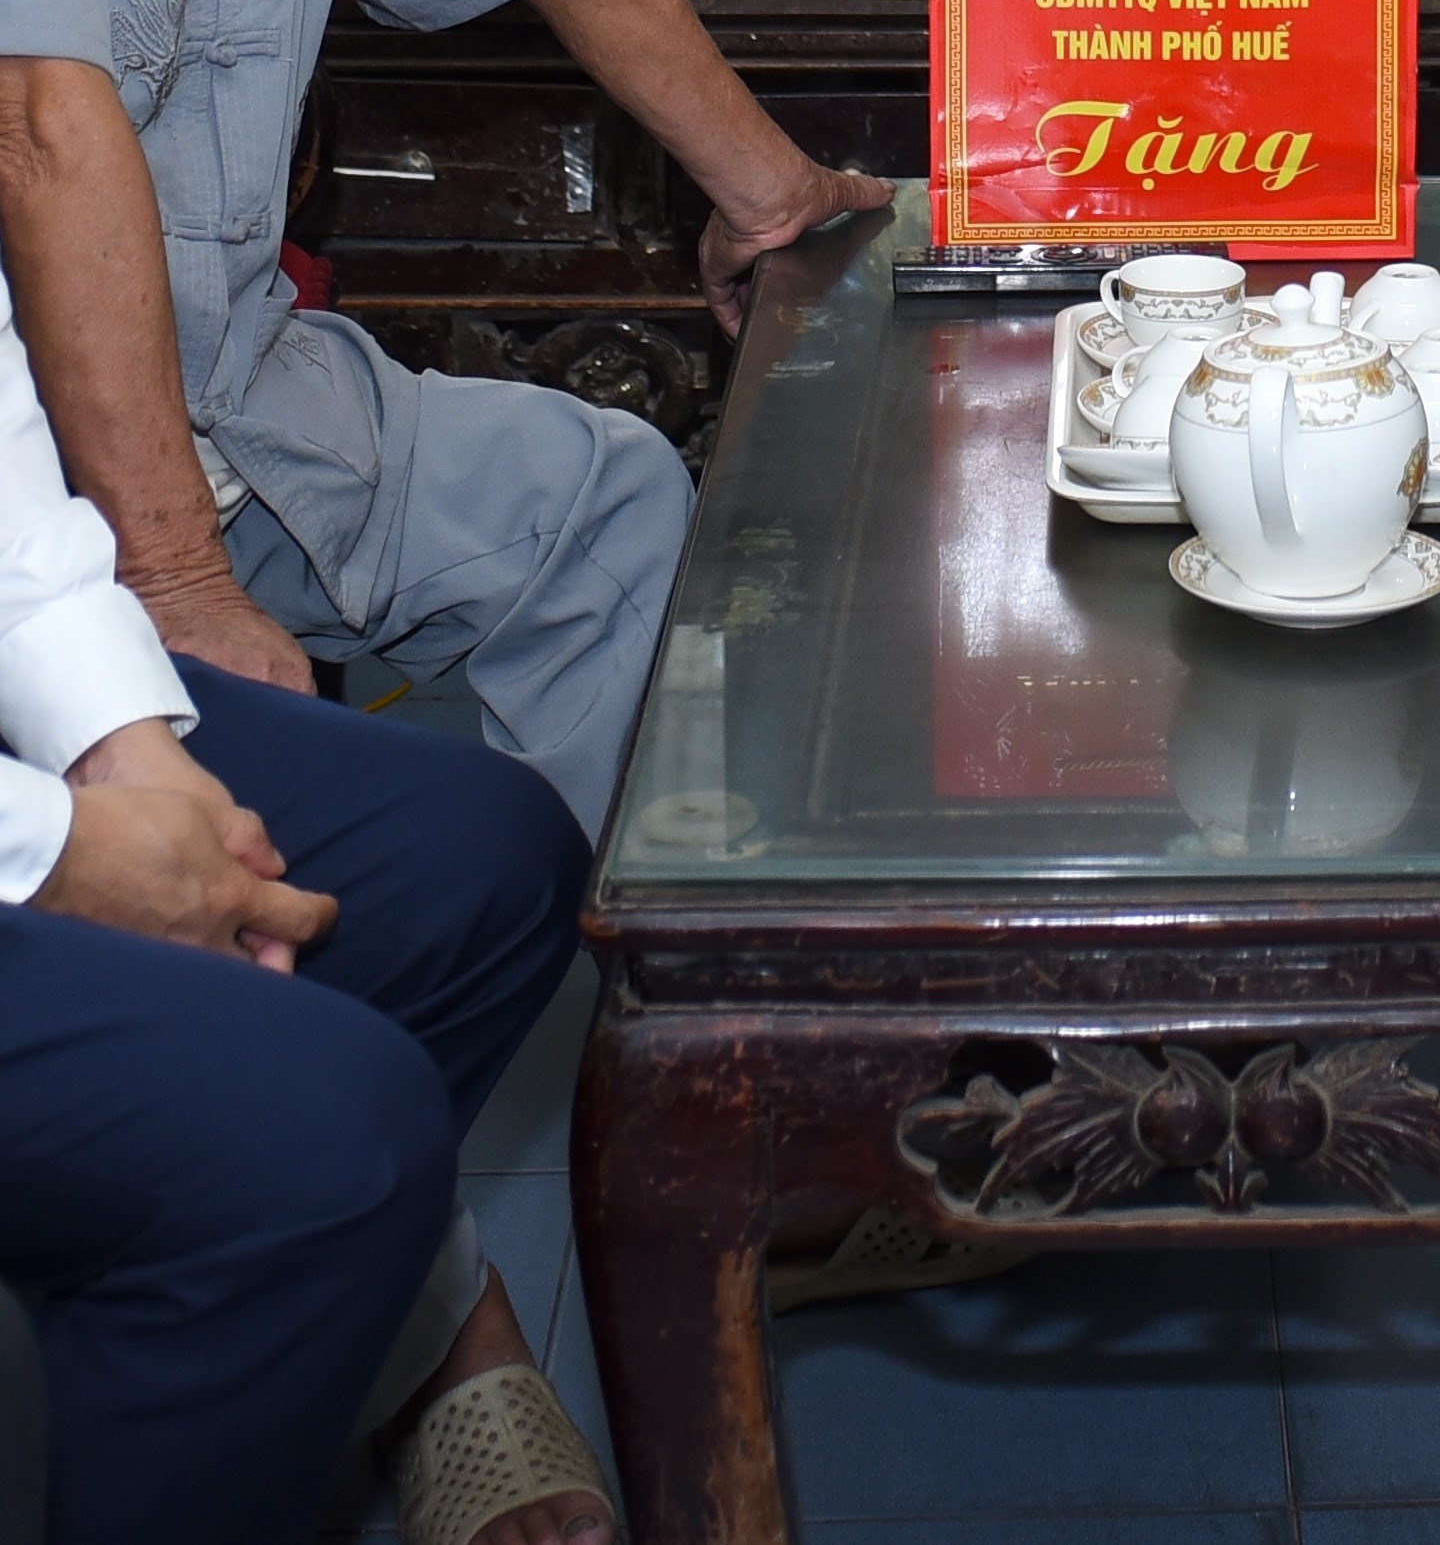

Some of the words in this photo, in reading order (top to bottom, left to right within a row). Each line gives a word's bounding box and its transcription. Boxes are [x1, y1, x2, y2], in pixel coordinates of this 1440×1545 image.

[1051, 23, 1152, 60] THÀNH
[1161, 20, 1223, 61] PHỐ
[1232, 21, 1293, 61] HUẾ
[1035, 100, 1320, 191] Tặng
